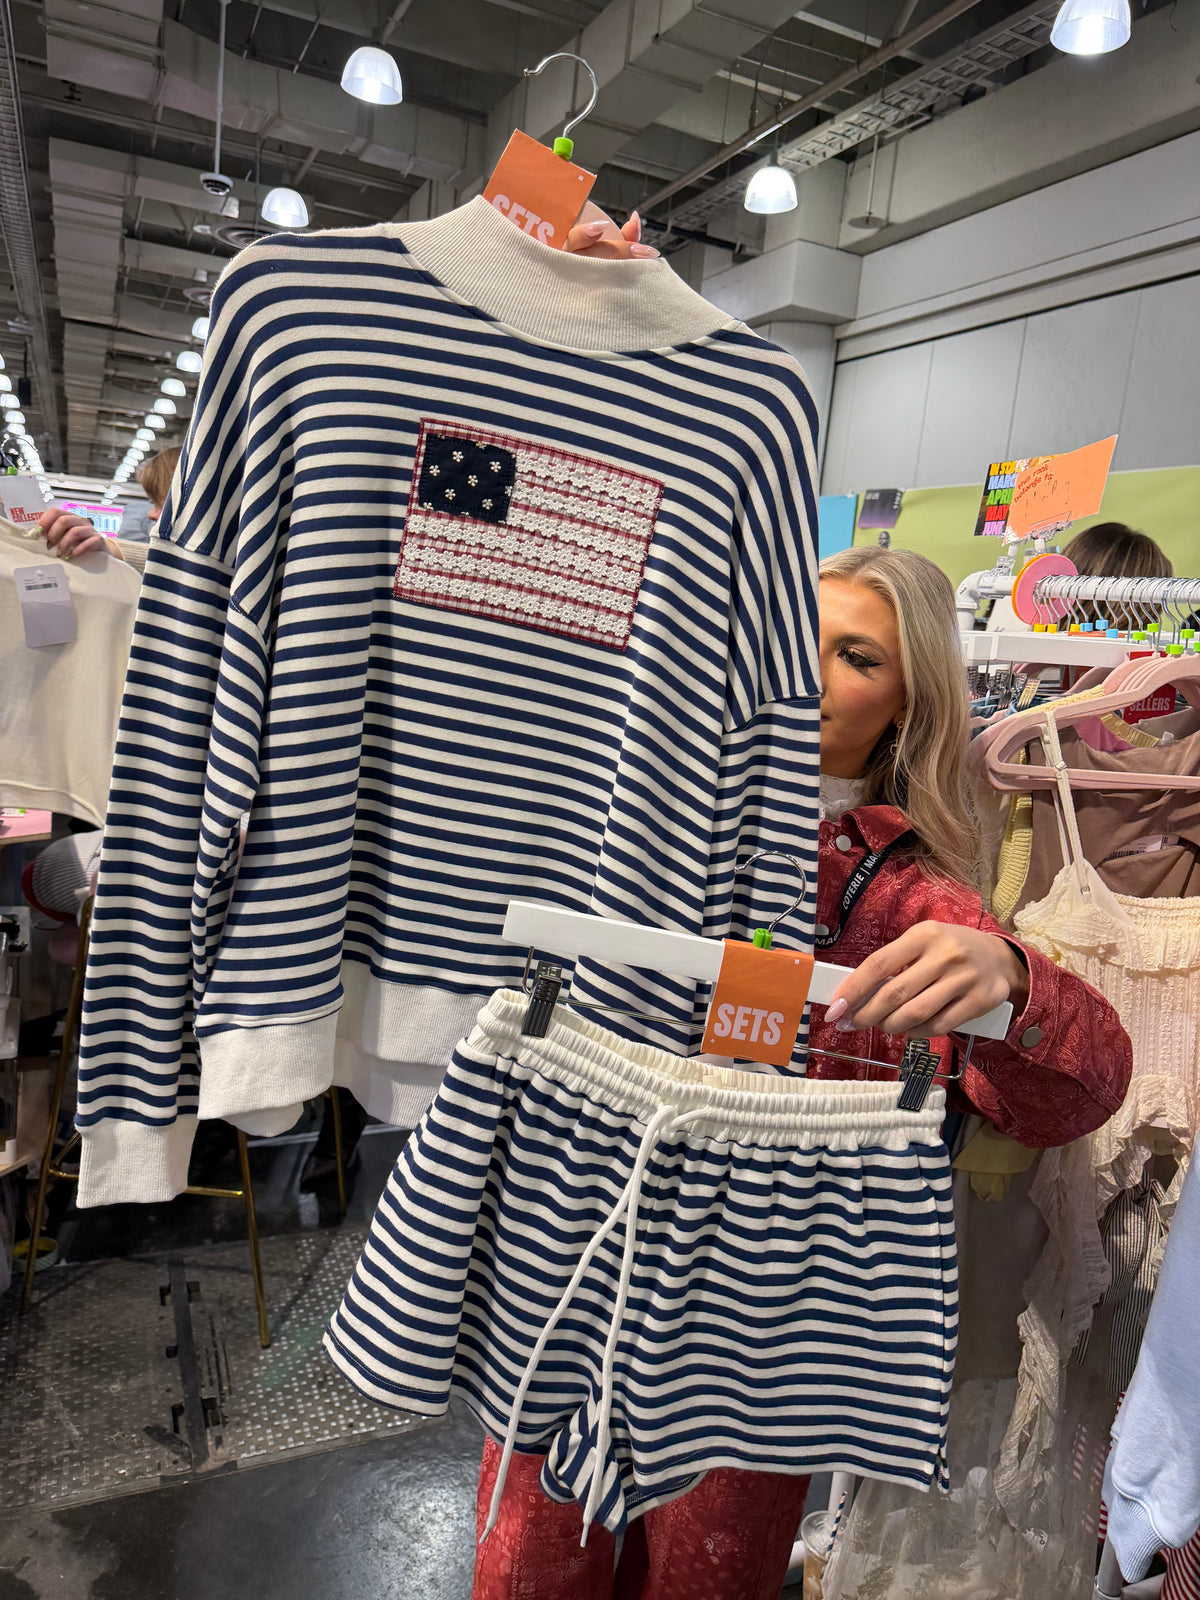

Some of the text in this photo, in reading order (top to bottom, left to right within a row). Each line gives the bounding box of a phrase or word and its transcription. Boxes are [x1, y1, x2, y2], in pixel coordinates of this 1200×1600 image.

[988, 473, 1018, 490] MARC
[985, 505, 1010, 521] MAY
[1130, 697, 1171, 712] SELLERS
[842, 872, 865, 910] COTERIE
[713, 1003, 785, 1046] SETS
